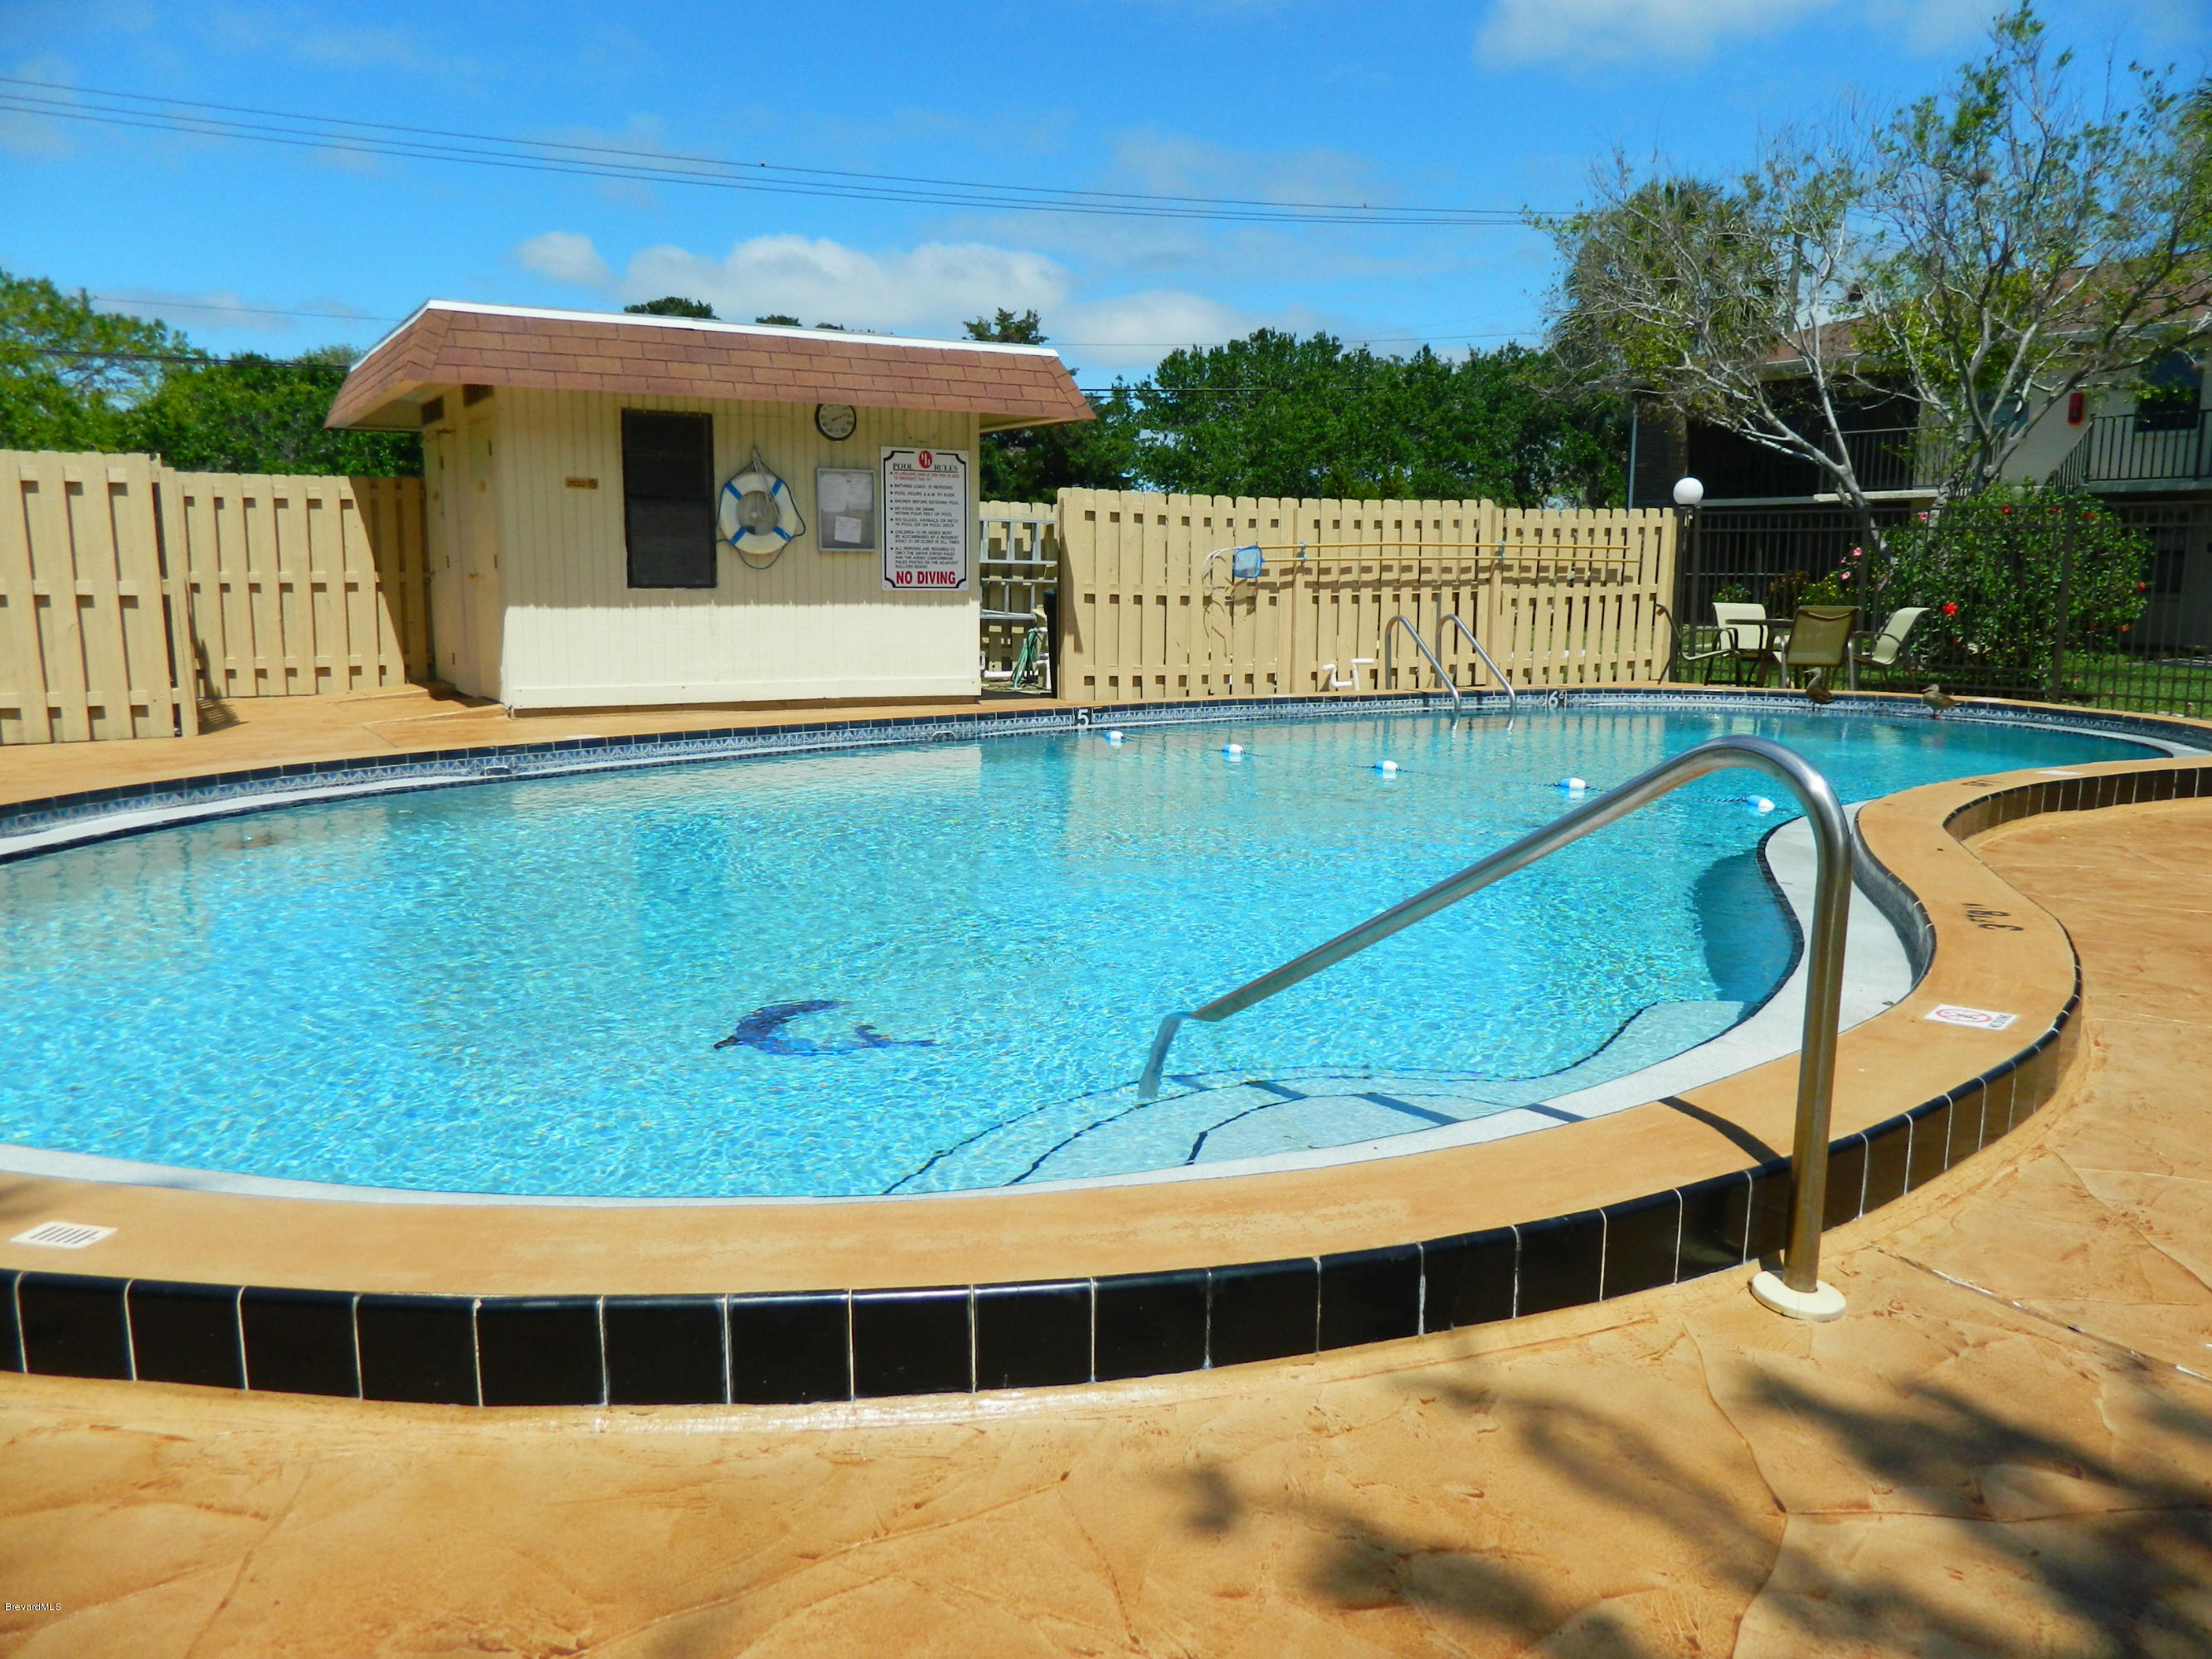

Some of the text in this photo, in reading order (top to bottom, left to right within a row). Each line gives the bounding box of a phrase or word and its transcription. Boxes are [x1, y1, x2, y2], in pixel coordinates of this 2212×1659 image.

[897, 571, 956, 585] NO DIVING
[1077, 708, 1089, 728] 5
